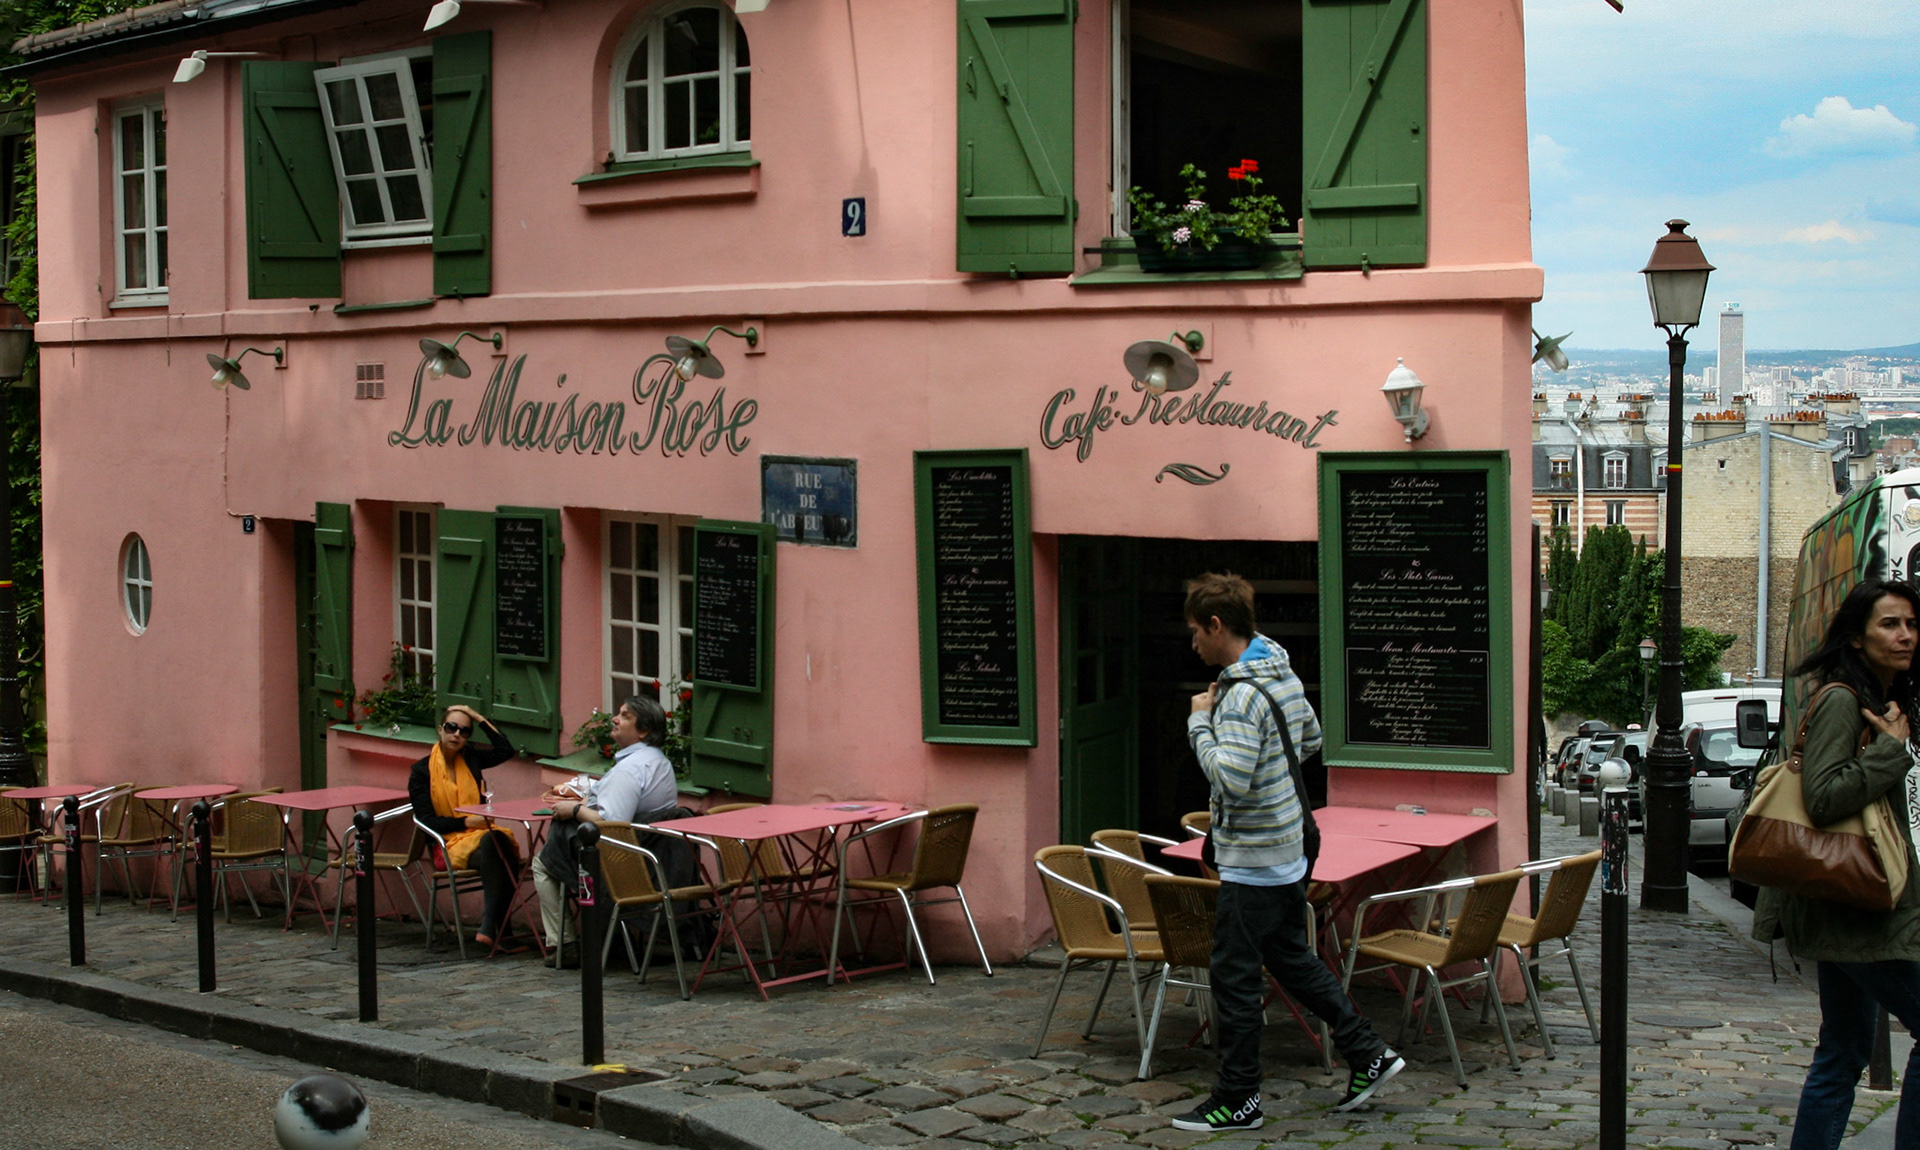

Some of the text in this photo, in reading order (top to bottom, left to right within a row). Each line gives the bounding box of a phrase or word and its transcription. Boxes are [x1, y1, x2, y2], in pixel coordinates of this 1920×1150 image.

[847, 201, 860, 234] 2
[388, 353, 759, 457] La Maison Rose
[795, 473, 822, 488] RUE
[1390, 478, 1439, 488] Les Entrées
[800, 494, 817, 508] DE
[246, 519, 251, 530] 2
[1380, 569, 1395, 580] Les
[1377, 642, 1457, 653] Menu Montmartre
